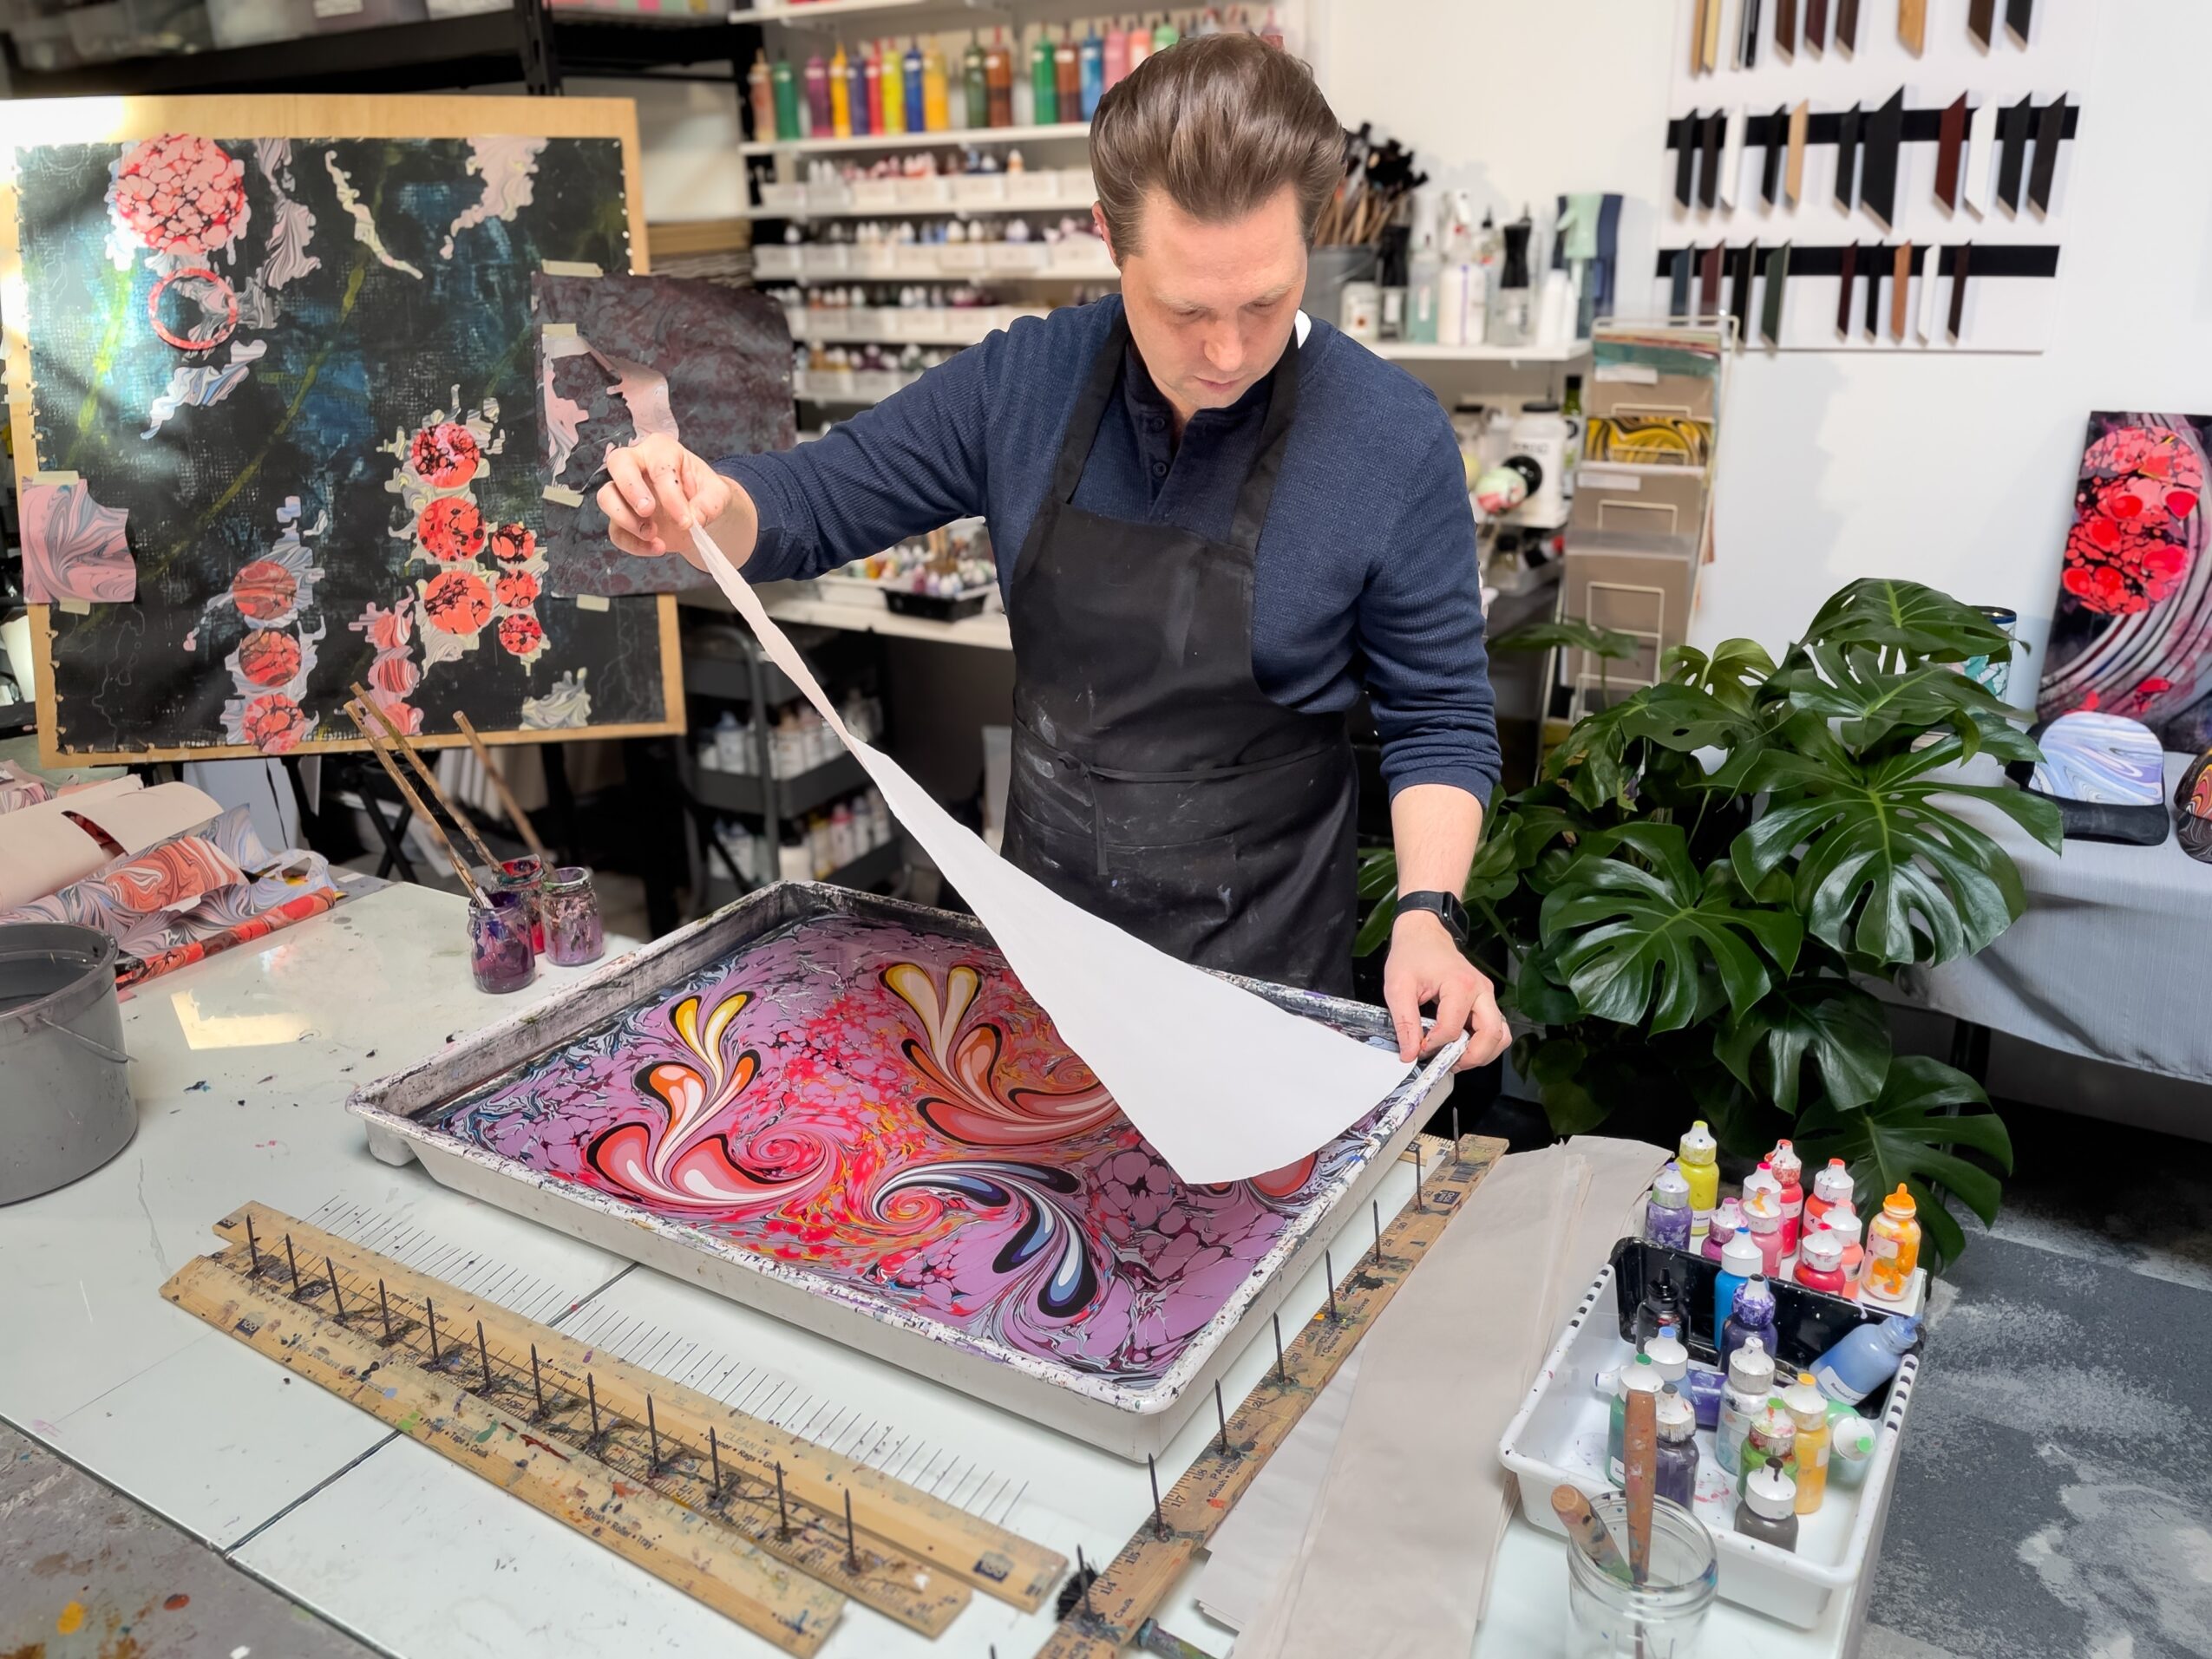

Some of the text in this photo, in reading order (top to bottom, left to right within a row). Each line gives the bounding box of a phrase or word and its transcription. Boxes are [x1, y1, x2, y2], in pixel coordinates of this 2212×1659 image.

[239, 1317, 259, 1333] 100
[559, 1357, 586, 1374] PAINT
[450, 1431, 466, 1446] Tape
[723, 1431, 757, 1453] CLEAN
[737, 1449, 756, 1464] Rags
[1208, 1479, 1228, 1499] Brush
[1171, 1494, 1186, 1509] 17
[584, 1506, 654, 1551] Brush Roller Tray
[1101, 1581, 1117, 1596] 14
